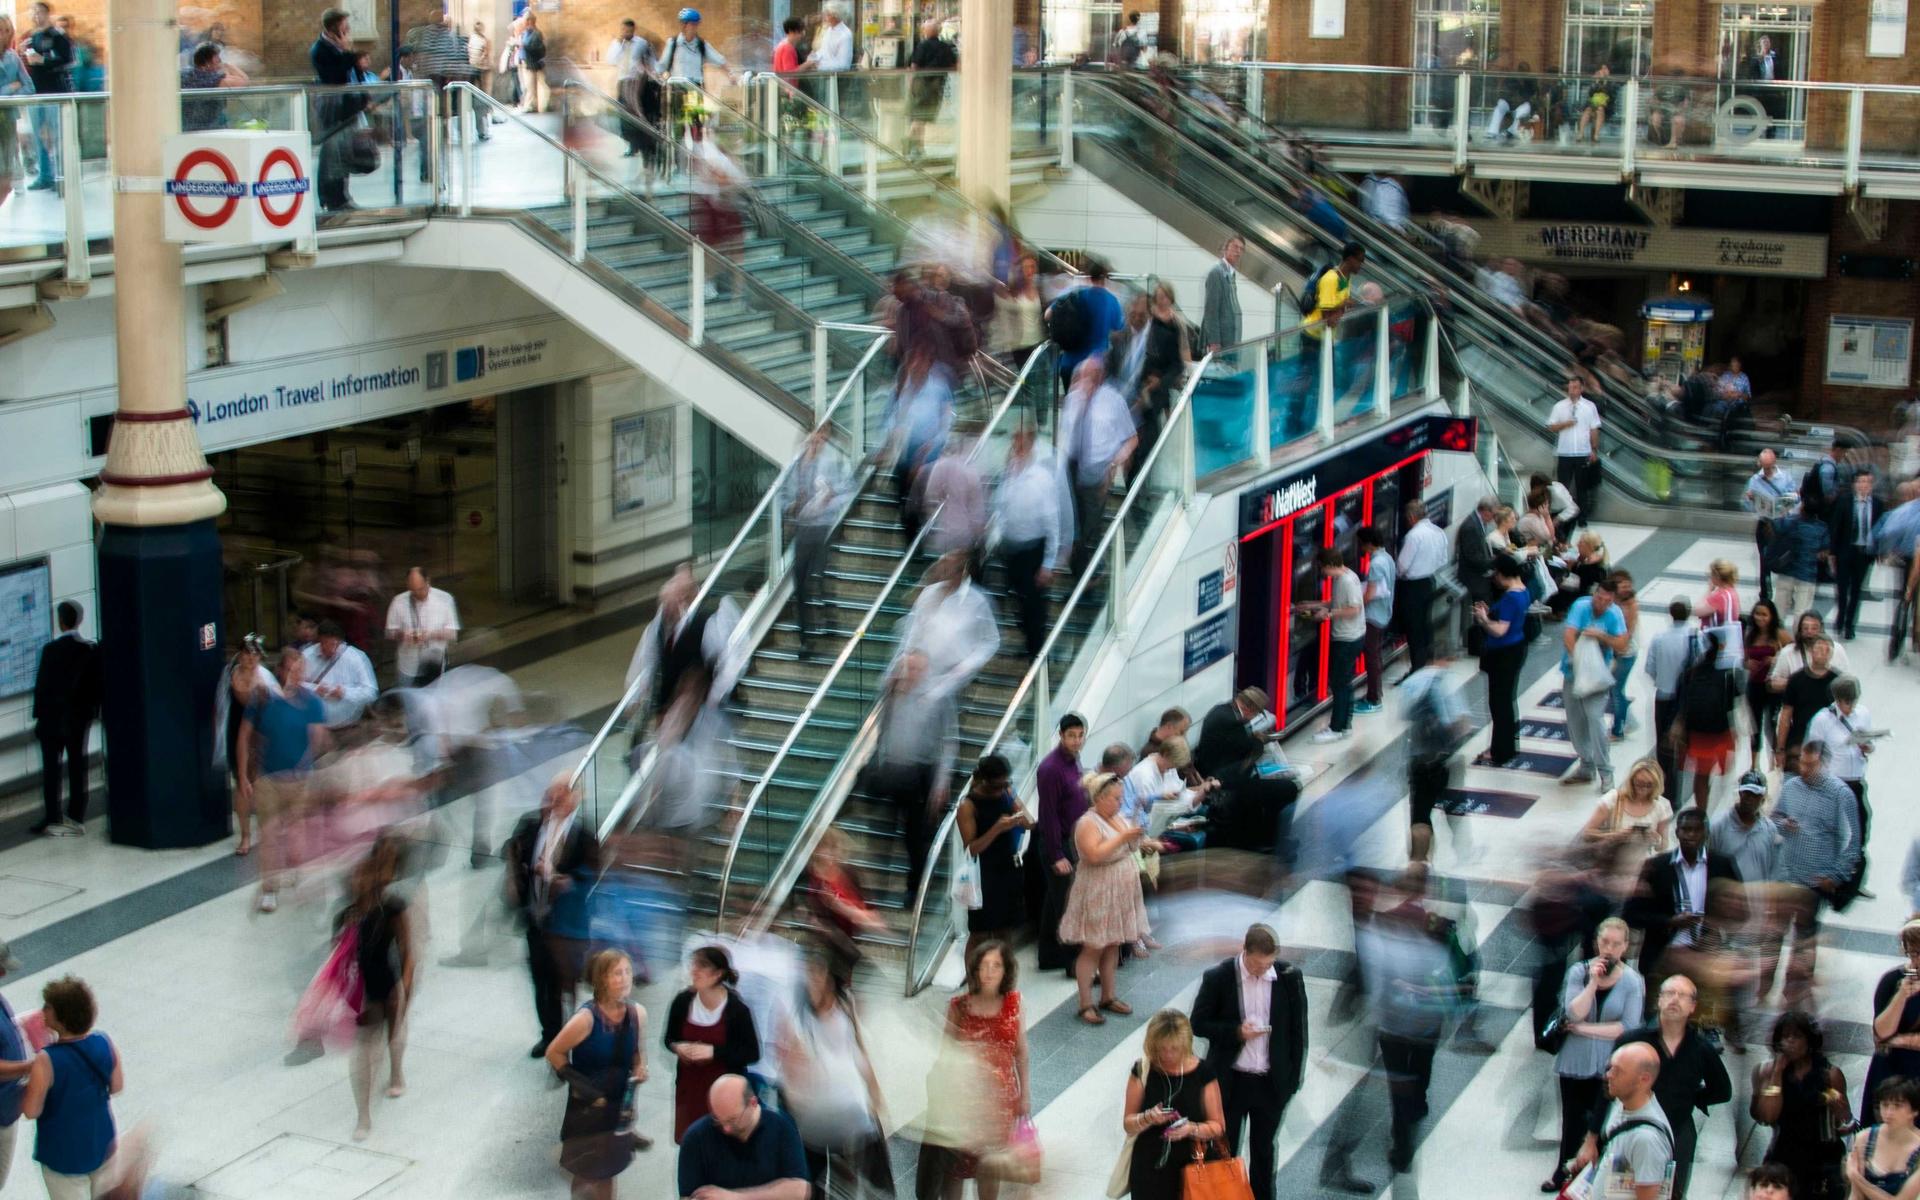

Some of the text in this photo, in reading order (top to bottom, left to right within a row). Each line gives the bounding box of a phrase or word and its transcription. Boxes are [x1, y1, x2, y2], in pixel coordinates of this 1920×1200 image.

[171, 182, 243, 195] UNDERGROUND
[255, 180, 308, 194] UNDERGROUND
[1542, 225, 1650, 249] MERCHANT
[206, 365, 420, 423] London Travel Information
[1275, 474, 1317, 519] NatWest
